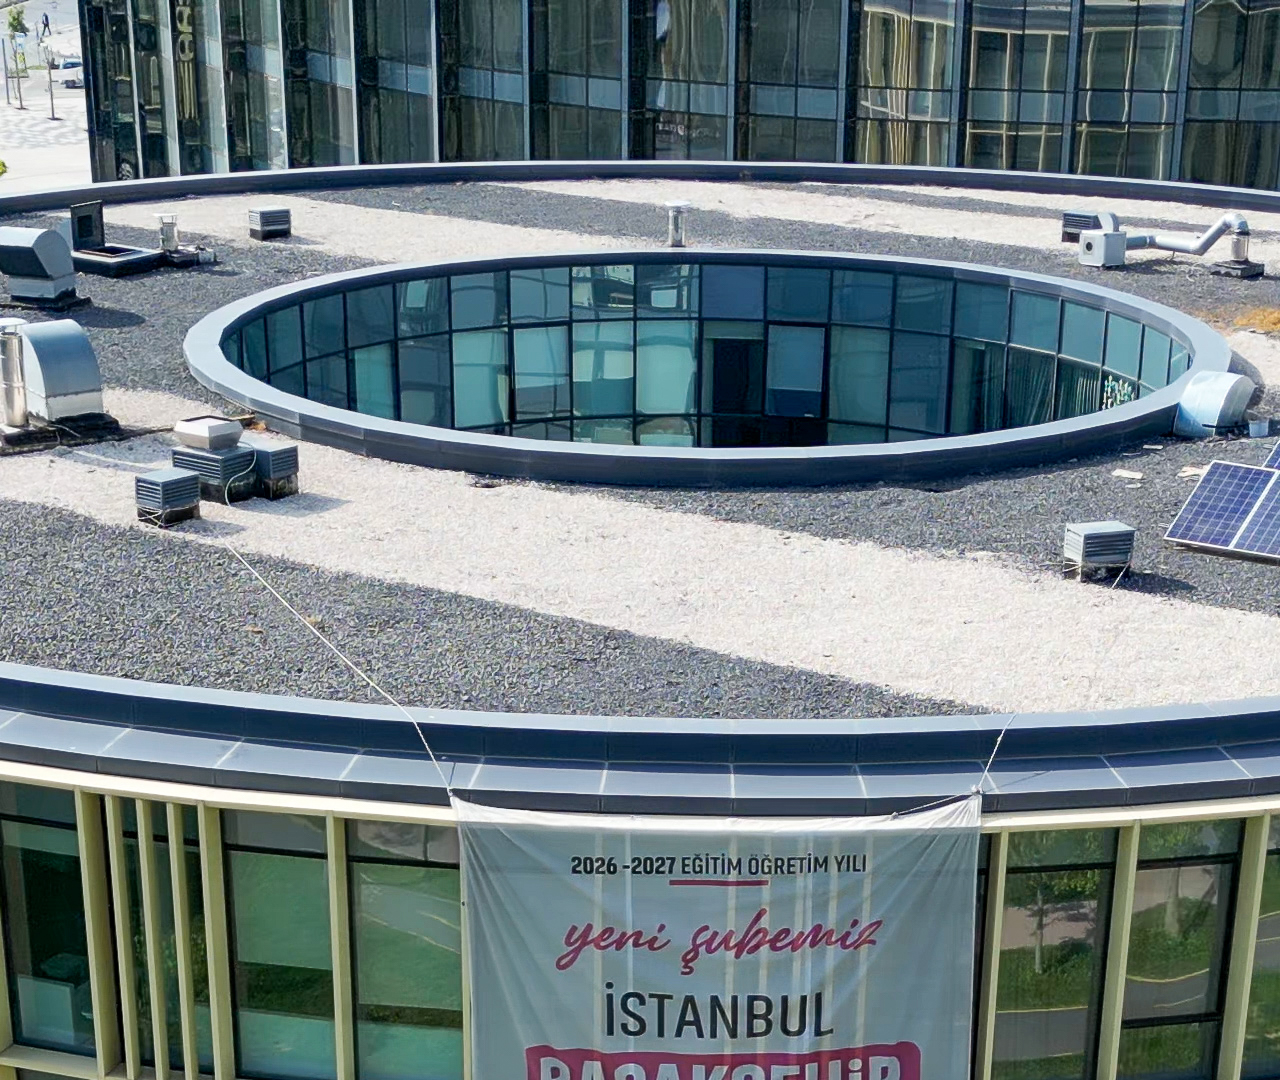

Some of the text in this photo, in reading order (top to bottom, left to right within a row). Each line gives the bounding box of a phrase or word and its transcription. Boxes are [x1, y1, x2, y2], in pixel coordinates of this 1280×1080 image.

[571, 856, 618, 875] 2026
[681, 853, 742, 875] EĞİTİM
[748, 852, 829, 875] ÖĞRETİM
[834, 854, 868, 873] YILI
[555, 907, 885, 976] yeni şubemiz
[605, 981, 834, 1039] İSTANBUL
